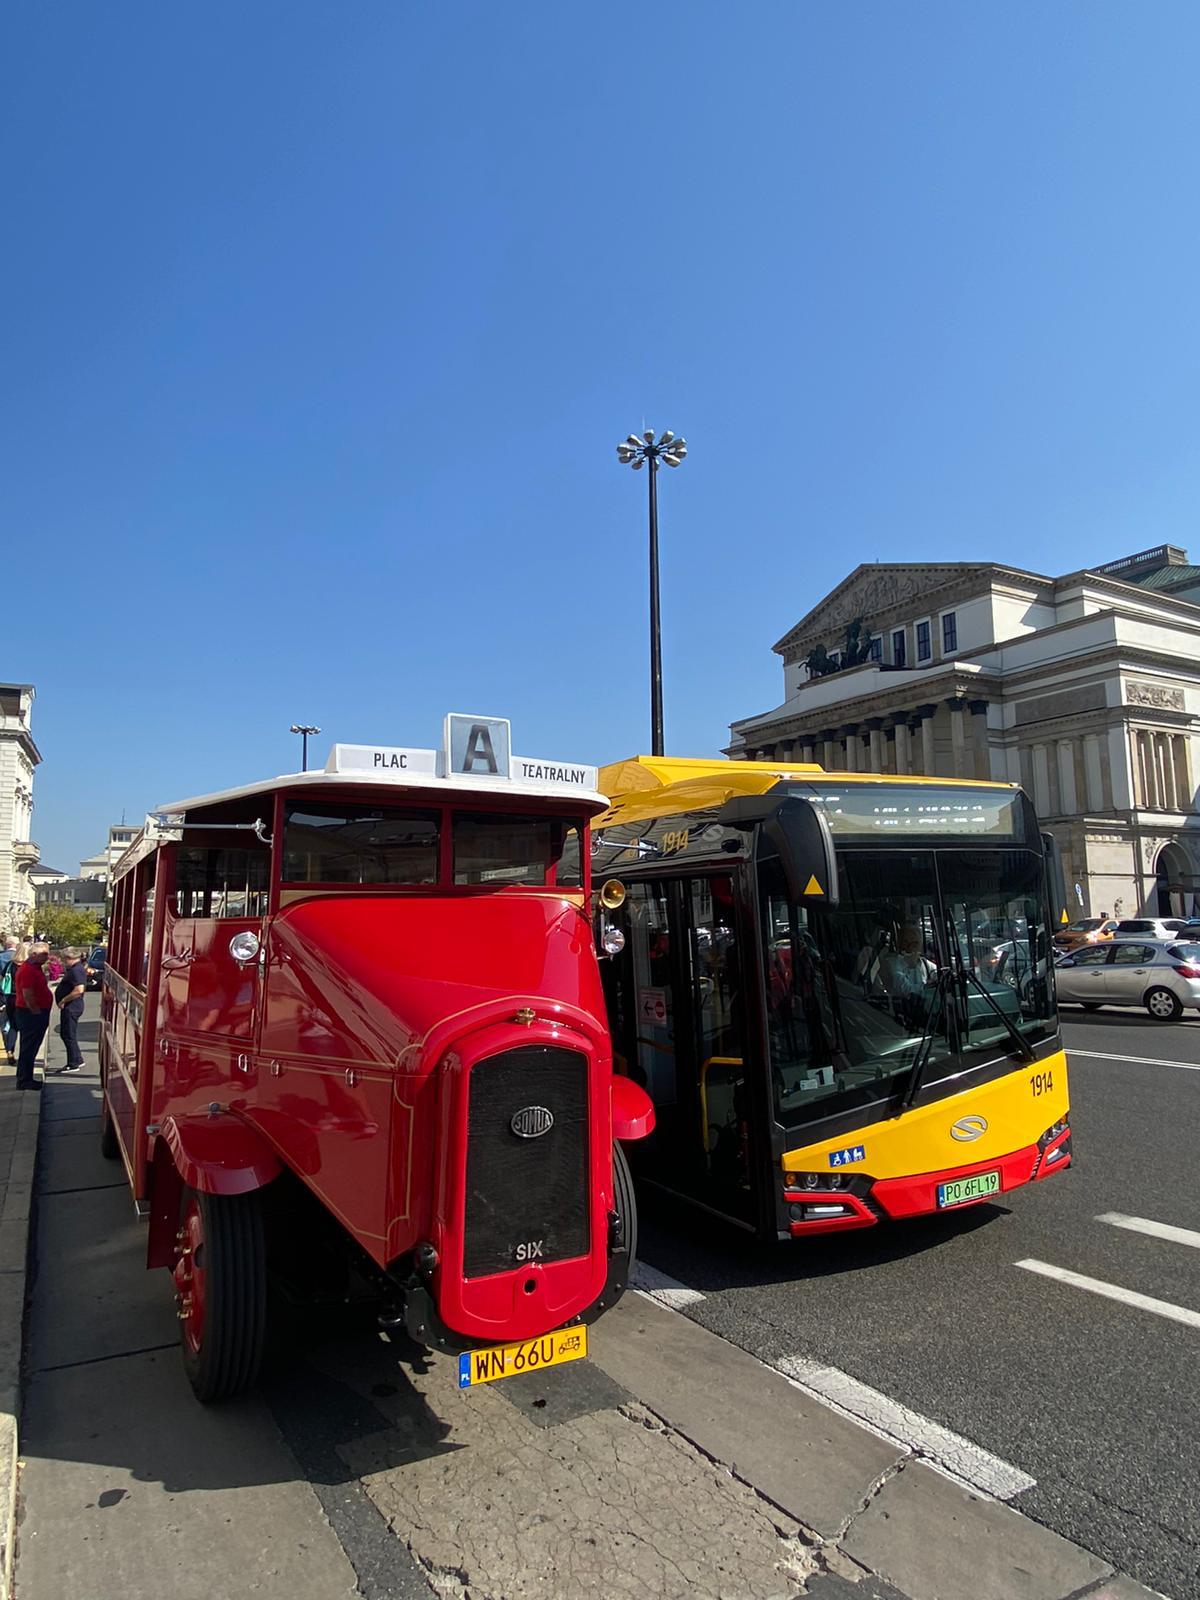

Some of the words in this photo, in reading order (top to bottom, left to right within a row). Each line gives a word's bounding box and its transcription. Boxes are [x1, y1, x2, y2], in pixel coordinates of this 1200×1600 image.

[462, 724, 498, 773] A
[373, 753, 408, 769] PLAC
[522, 763, 586, 784] TEATRALNY
[662, 829, 689, 852] 1914
[1030, 1071, 1053, 1097] 1914
[514, 1110, 551, 1134] SOMUA
[946, 1183, 961, 1201] PO
[964, 1174, 997, 1196] 6FL19
[515, 1240, 543, 1261] SIX
[476, 1349, 505, 1380] WN
[514, 1338, 554, 1370] 66U
[461, 1373, 470, 1381] PL
